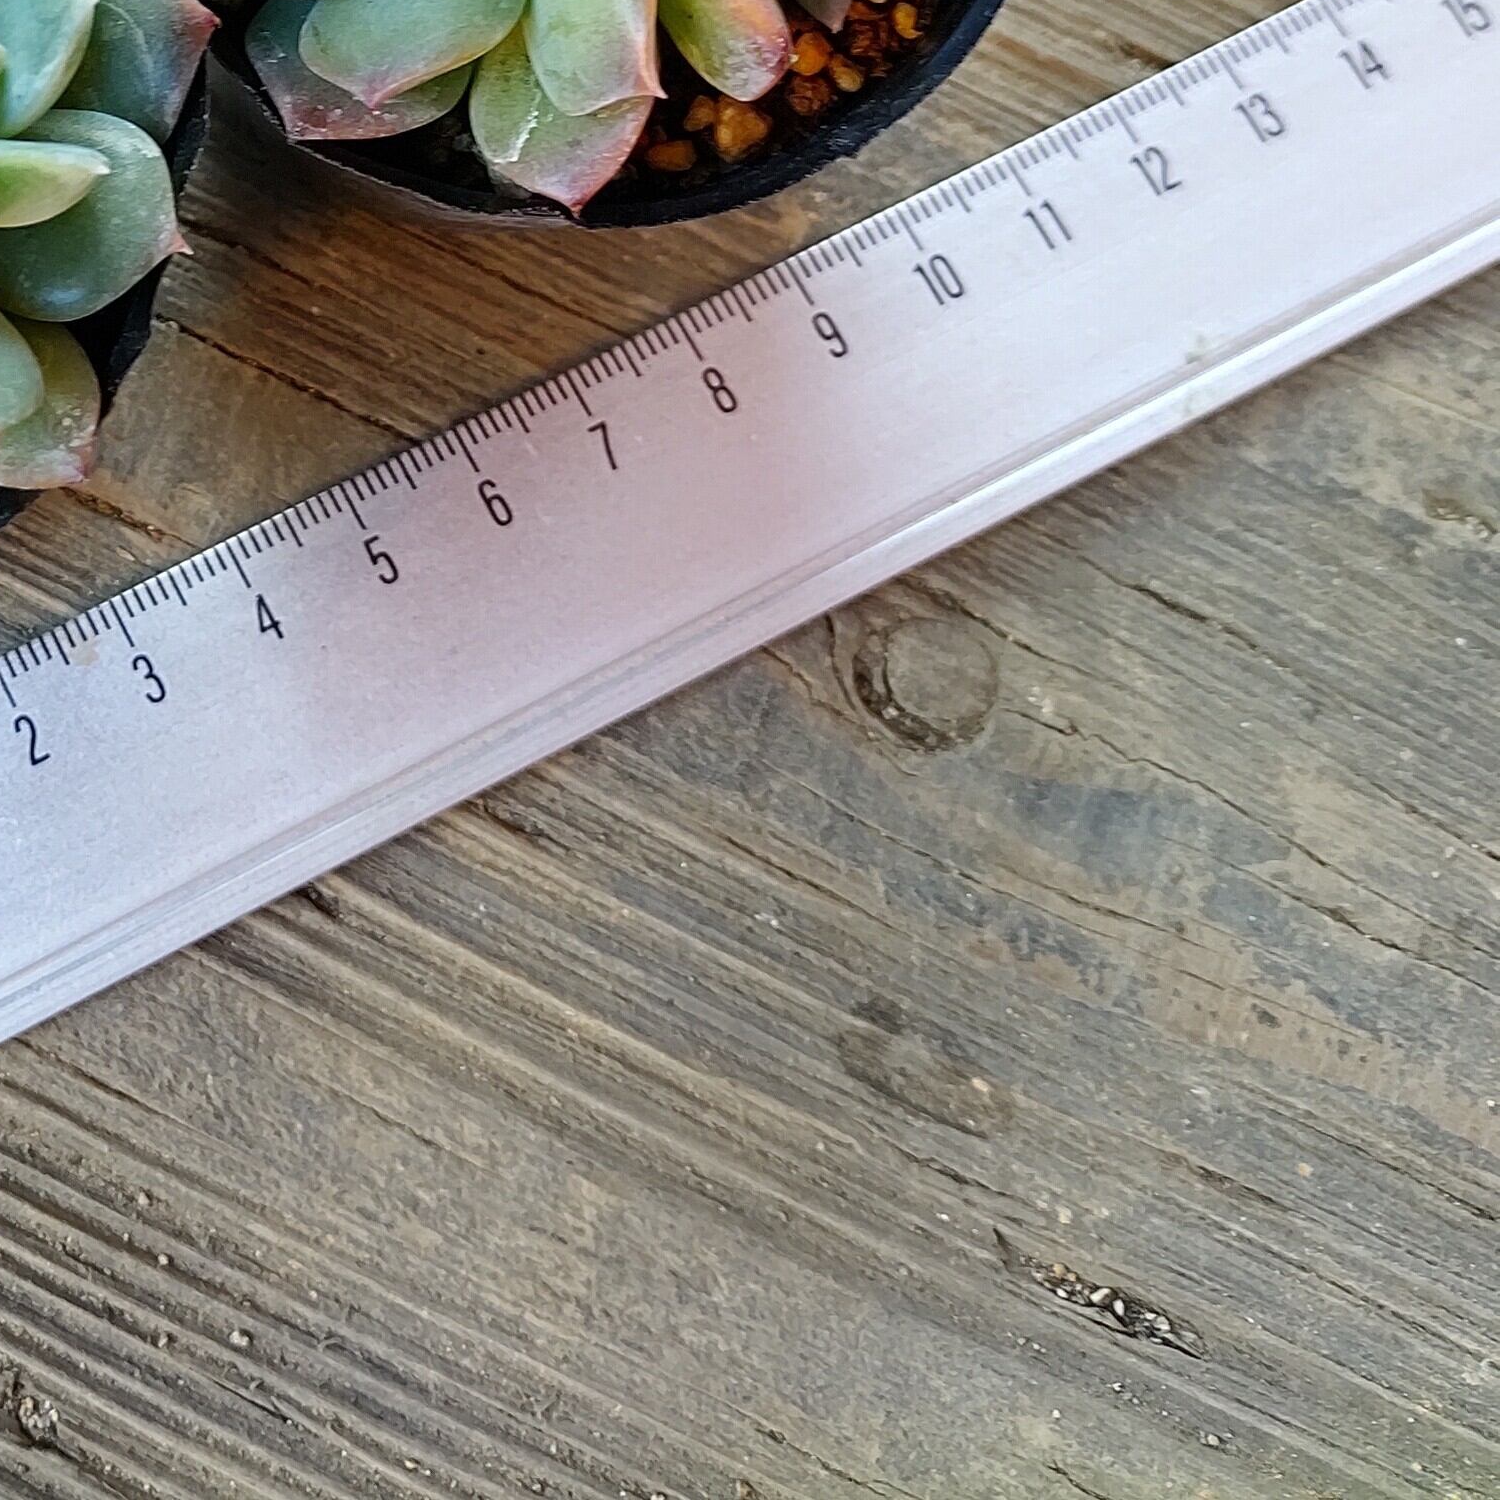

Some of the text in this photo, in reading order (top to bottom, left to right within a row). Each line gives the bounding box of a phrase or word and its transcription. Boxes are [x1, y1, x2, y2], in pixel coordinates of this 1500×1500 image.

[14, 715, 51, 766] 2
[131, 654, 166, 704] 3
[256, 593, 285, 640] 4
[363, 535, 399, 585] 5
[477, 479, 513, 527] 6
[587, 421, 618, 471] 7
[702, 367, 738, 414] 8
[812, 312, 848, 358] 9
[913, 254, 965, 306] 10
[1024, 200, 1072, 250] 11
[1130, 146, 1183, 197] 12
[1234, 93, 1286, 143] 13
[1338, 41, 1390, 91] 14
